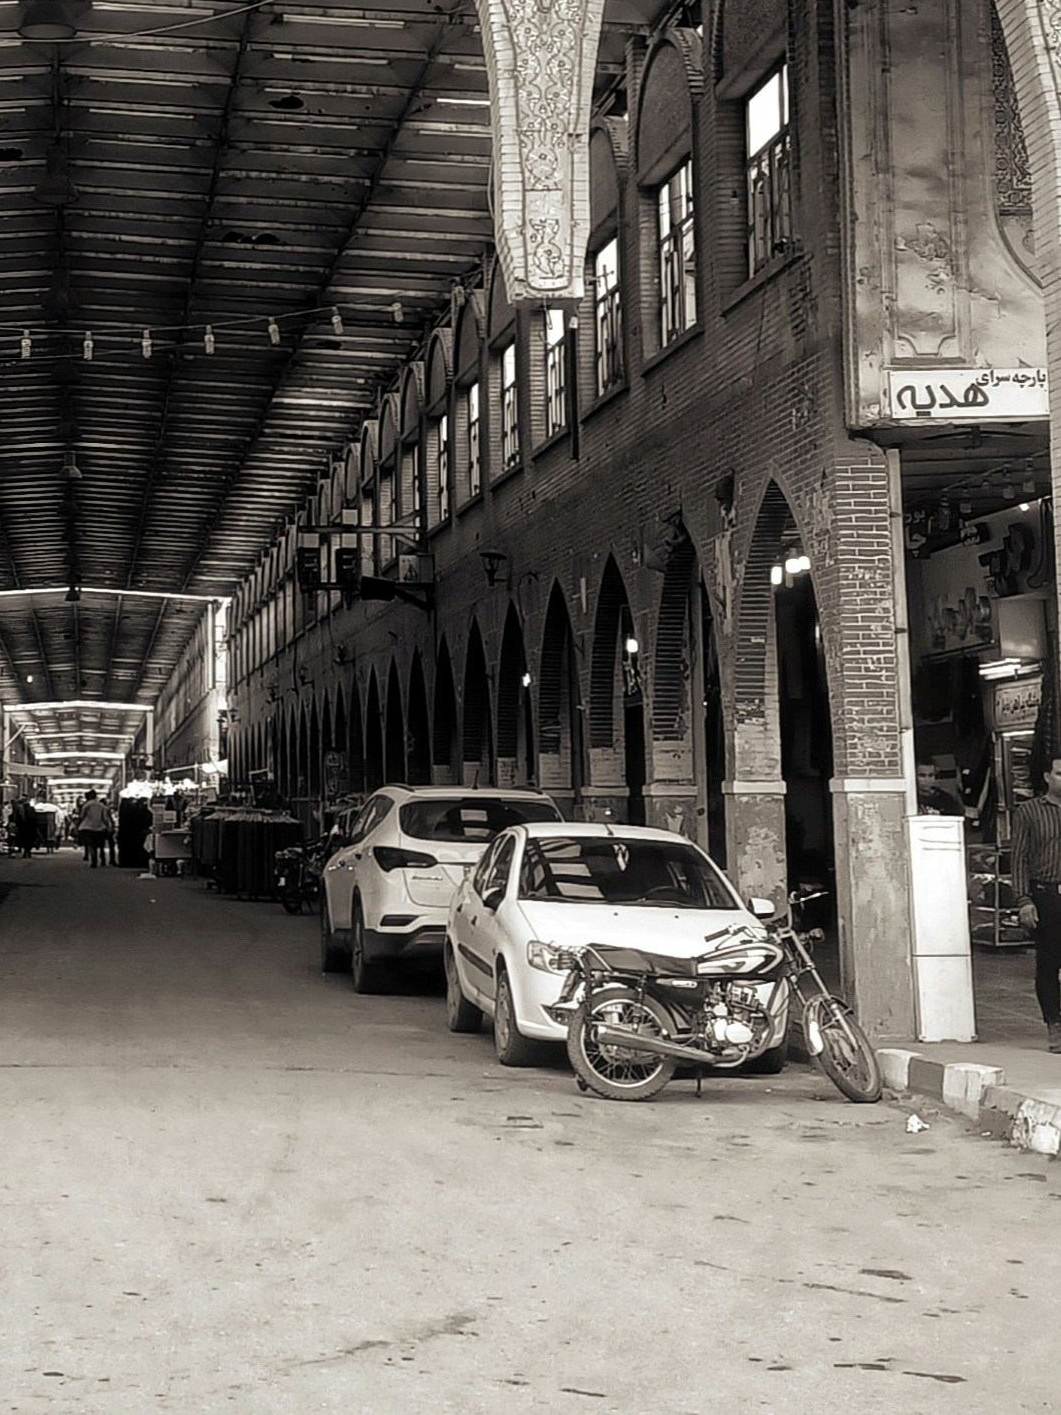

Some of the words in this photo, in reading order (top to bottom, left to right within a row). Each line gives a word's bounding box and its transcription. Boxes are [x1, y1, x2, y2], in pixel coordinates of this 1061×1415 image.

[975, 369, 1011, 387] سرای
[1012, 369, 1046, 389] پارچه
[896, 383, 990, 417] هدیه
